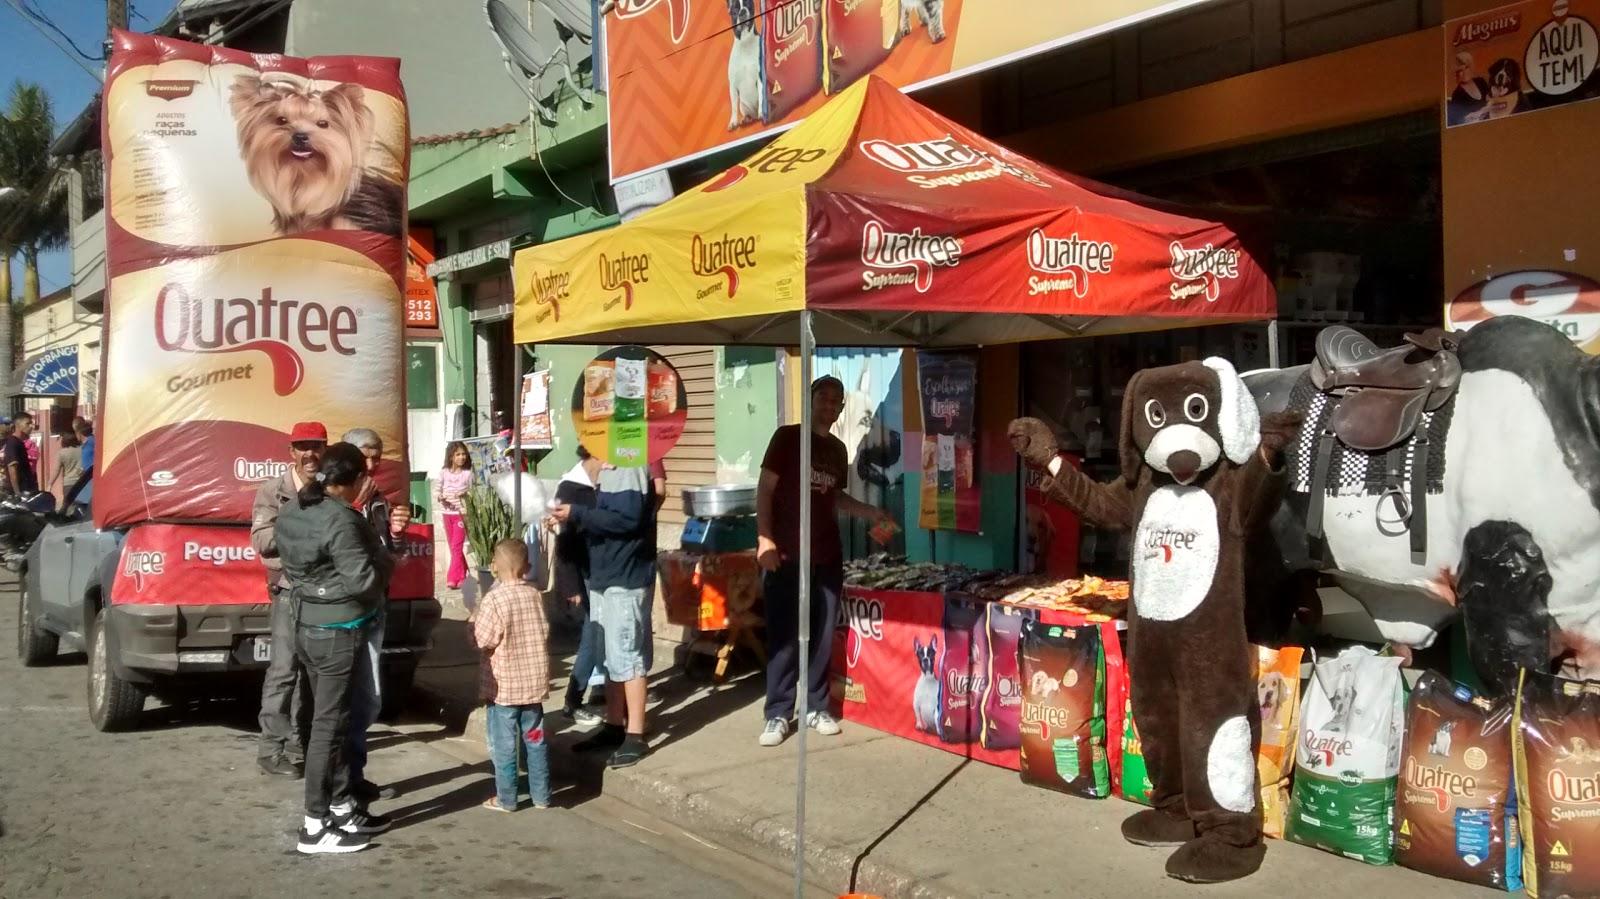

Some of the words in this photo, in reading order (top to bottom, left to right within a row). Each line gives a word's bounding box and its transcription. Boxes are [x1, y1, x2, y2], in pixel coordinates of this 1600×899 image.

[1453, 16, 1518, 46] Magnus
[1539, 23, 1583, 60] AQUI
[149, 84, 190, 92] Premium
[155, 121, 185, 129] raças
[692, 233, 756, 284] Quatree
[862, 220, 962, 280] Quatree
[1027, 228, 1114, 285] Quatree
[599, 252, 649, 298] Quatree
[862, 270, 915, 291] Supreme
[1028, 276, 1074, 295] Supreme
[408, 300, 432, 310] 512
[408, 311, 432, 321] 293
[155, 282, 358, 372] Quatree
[35, 366, 78, 394] ASSADO
[166, 363, 254, 393] Gourmet
[184, 541, 257, 565] Pegue
[947, 668, 987, 699] Quatre
[996, 674, 1022, 698] Qua
[1406, 756, 1477, 805] Quatree
[1548, 768, 1600, 804] Quat
[1356, 825, 1378, 836] 15kg
[1550, 860, 1573, 873] 15kg
